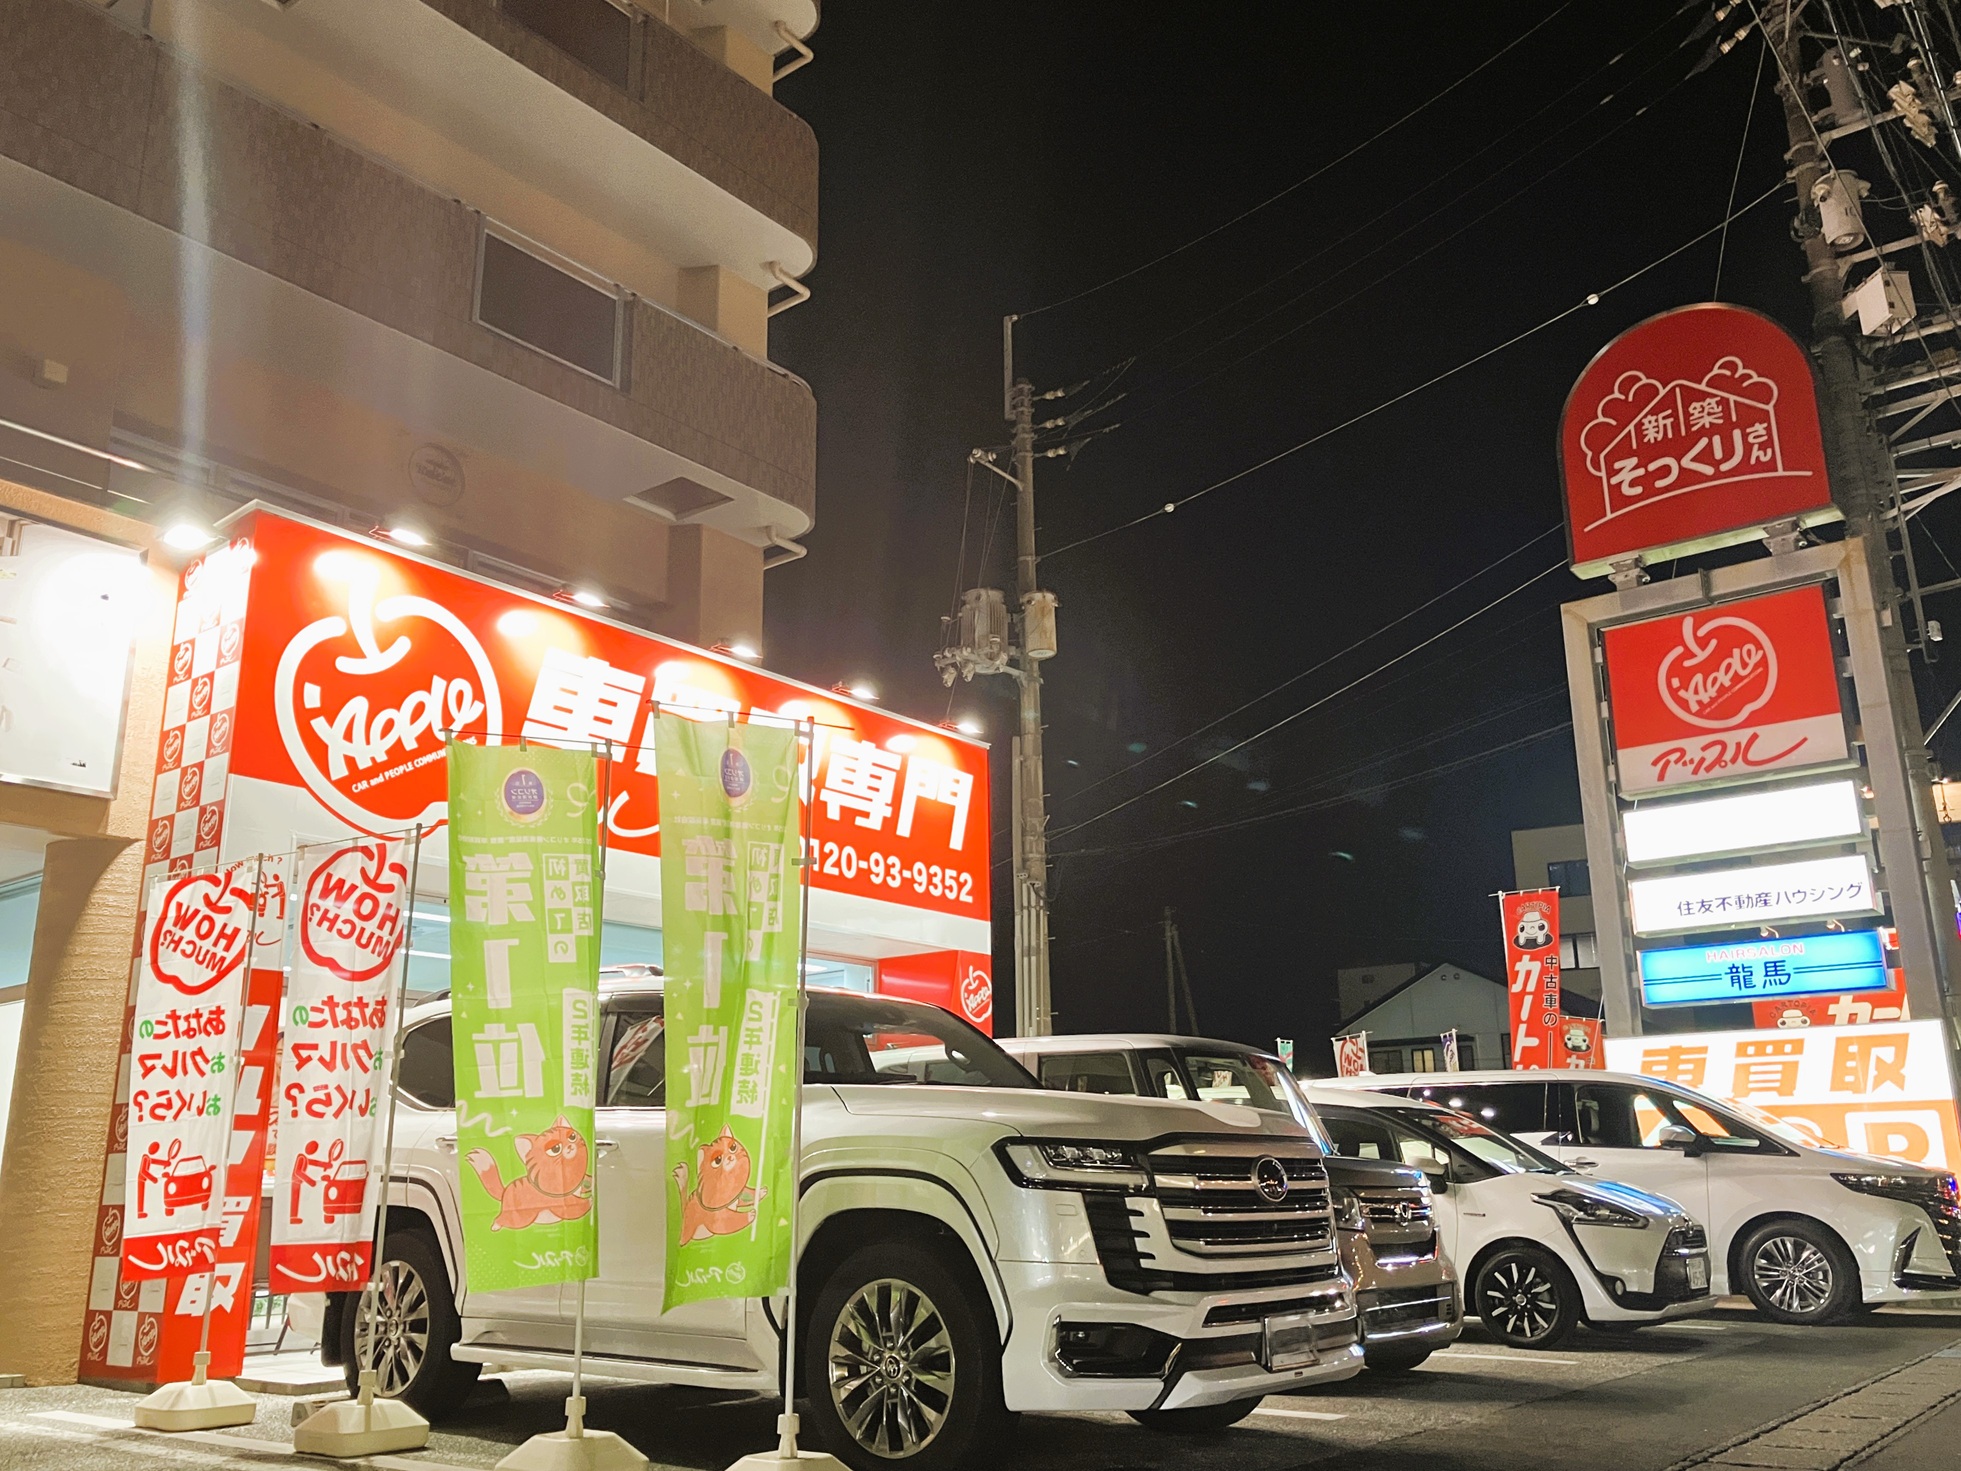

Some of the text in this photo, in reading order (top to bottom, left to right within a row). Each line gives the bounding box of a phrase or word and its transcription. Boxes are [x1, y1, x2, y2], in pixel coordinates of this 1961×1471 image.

[1641, 396, 1724, 444] 新築
[1610, 428, 1744, 497] そっくり
[351, 780, 370, 793] CAR
[369, 773, 385, 786] and
[384, 761, 414, 781] PEOPLE
[520, 647, 975, 852] 車専門
[1651, 731, 1809, 782] アップル
[1543, 954, 1558, 1027] 中古車の
[1725, 959, 1791, 991] 龍馬
[1511, 955, 1541, 1069] カート
